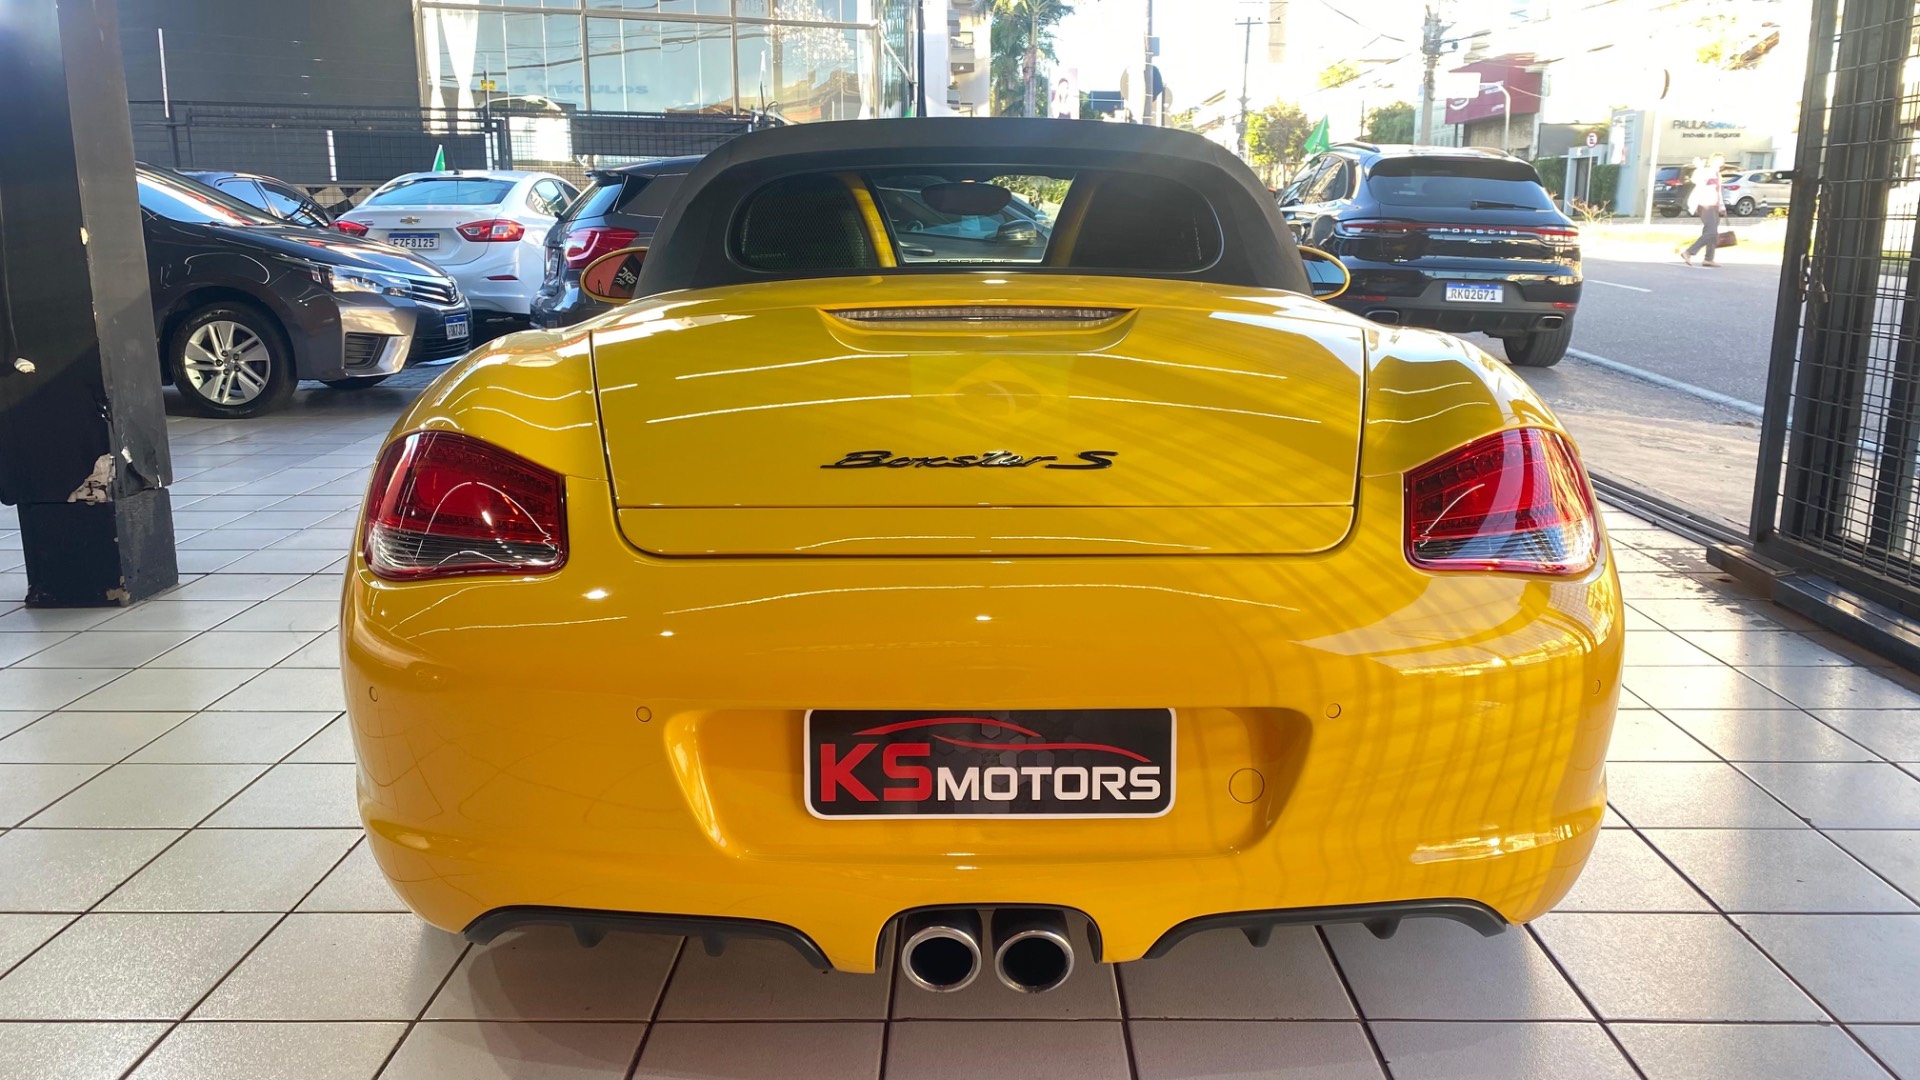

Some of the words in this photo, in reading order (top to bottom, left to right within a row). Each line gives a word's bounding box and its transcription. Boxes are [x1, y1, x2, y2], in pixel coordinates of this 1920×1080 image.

[1440, 227, 1518, 235] PORSCHE
[1450, 288, 1496, 300] RKQ2G71
[820, 451, 1057, 468] Boxster
[1045, 451, 1118, 469] S
[937, 766, 1161, 800] MOTORS
